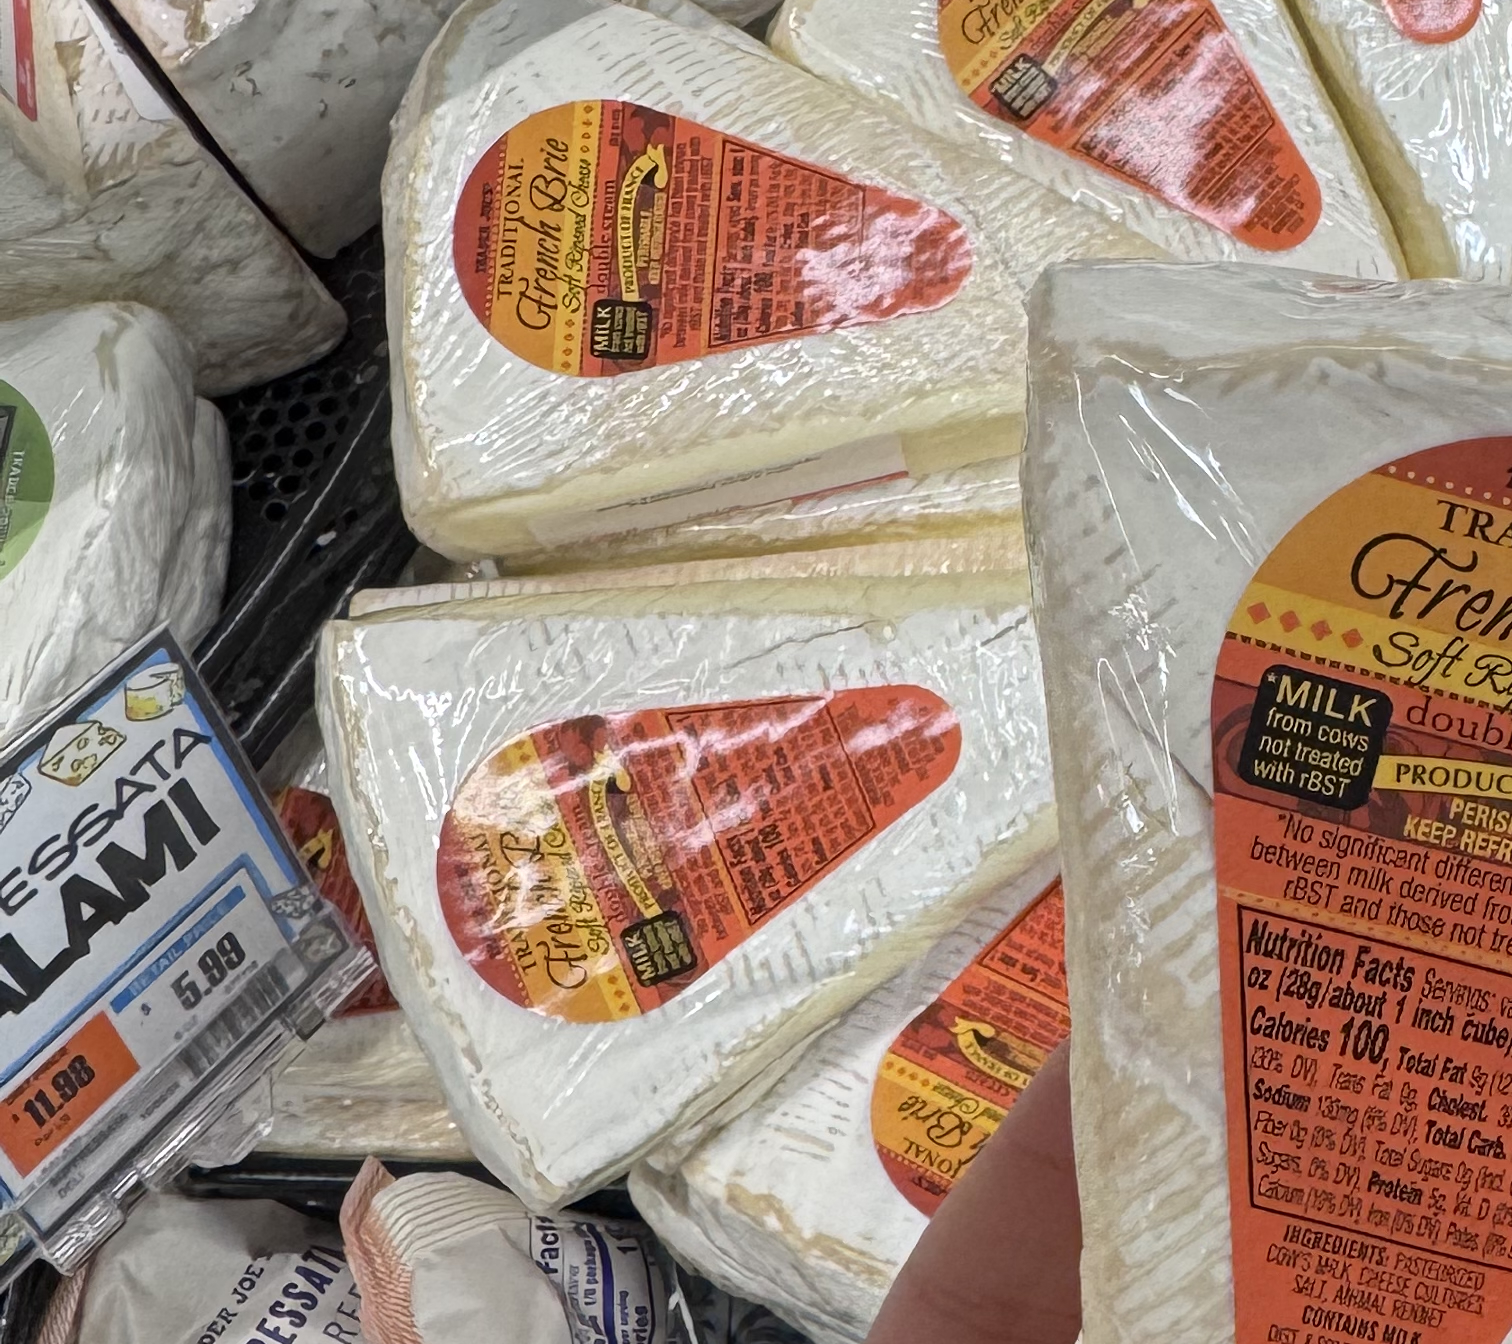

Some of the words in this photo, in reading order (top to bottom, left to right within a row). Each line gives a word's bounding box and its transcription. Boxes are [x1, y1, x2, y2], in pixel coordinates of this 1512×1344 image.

[530, 138, 568, 212] Brie
[497, 165, 523, 300] TRADITIONAL
[516, 216, 561, 330] French
[1373, 632, 1466, 681] Soft
[1259, 736, 1291, 757] not
[1295, 742, 1363, 775] treated
[1267, 707, 1311, 736] from
[1318, 726, 1368, 751] cows
[1255, 760, 1294, 783] with
[1299, 771, 1351, 797] rBST
[1319, 827, 1430, 874] significant
[1404, 816, 1456, 847] KEEP
[1250, 836, 1344, 880] between
[1348, 867, 1394, 894] milk
[1400, 877, 1479, 915] derived
[1284, 878, 1334, 908] rBST
[1340, 895, 1383, 920] and
[1387, 904, 1446, 937] those
[1450, 923, 1487, 948] not
[171, 932, 245, 1010] 5.99
[1245, 919, 1345, 975] Nutrition
[1351, 945, 1415, 992] Facts
[1248, 967, 1272, 990] oz
[1395, 997, 1406, 1024] 1
[1411, 999, 1454, 1036] inch
[1250, 1006, 1330, 1052] Calories
[1397, 1046, 1439, 1077] Total
[1439, 1057, 1468, 1085] Fat
[898, 1096, 972, 1148] Brie
